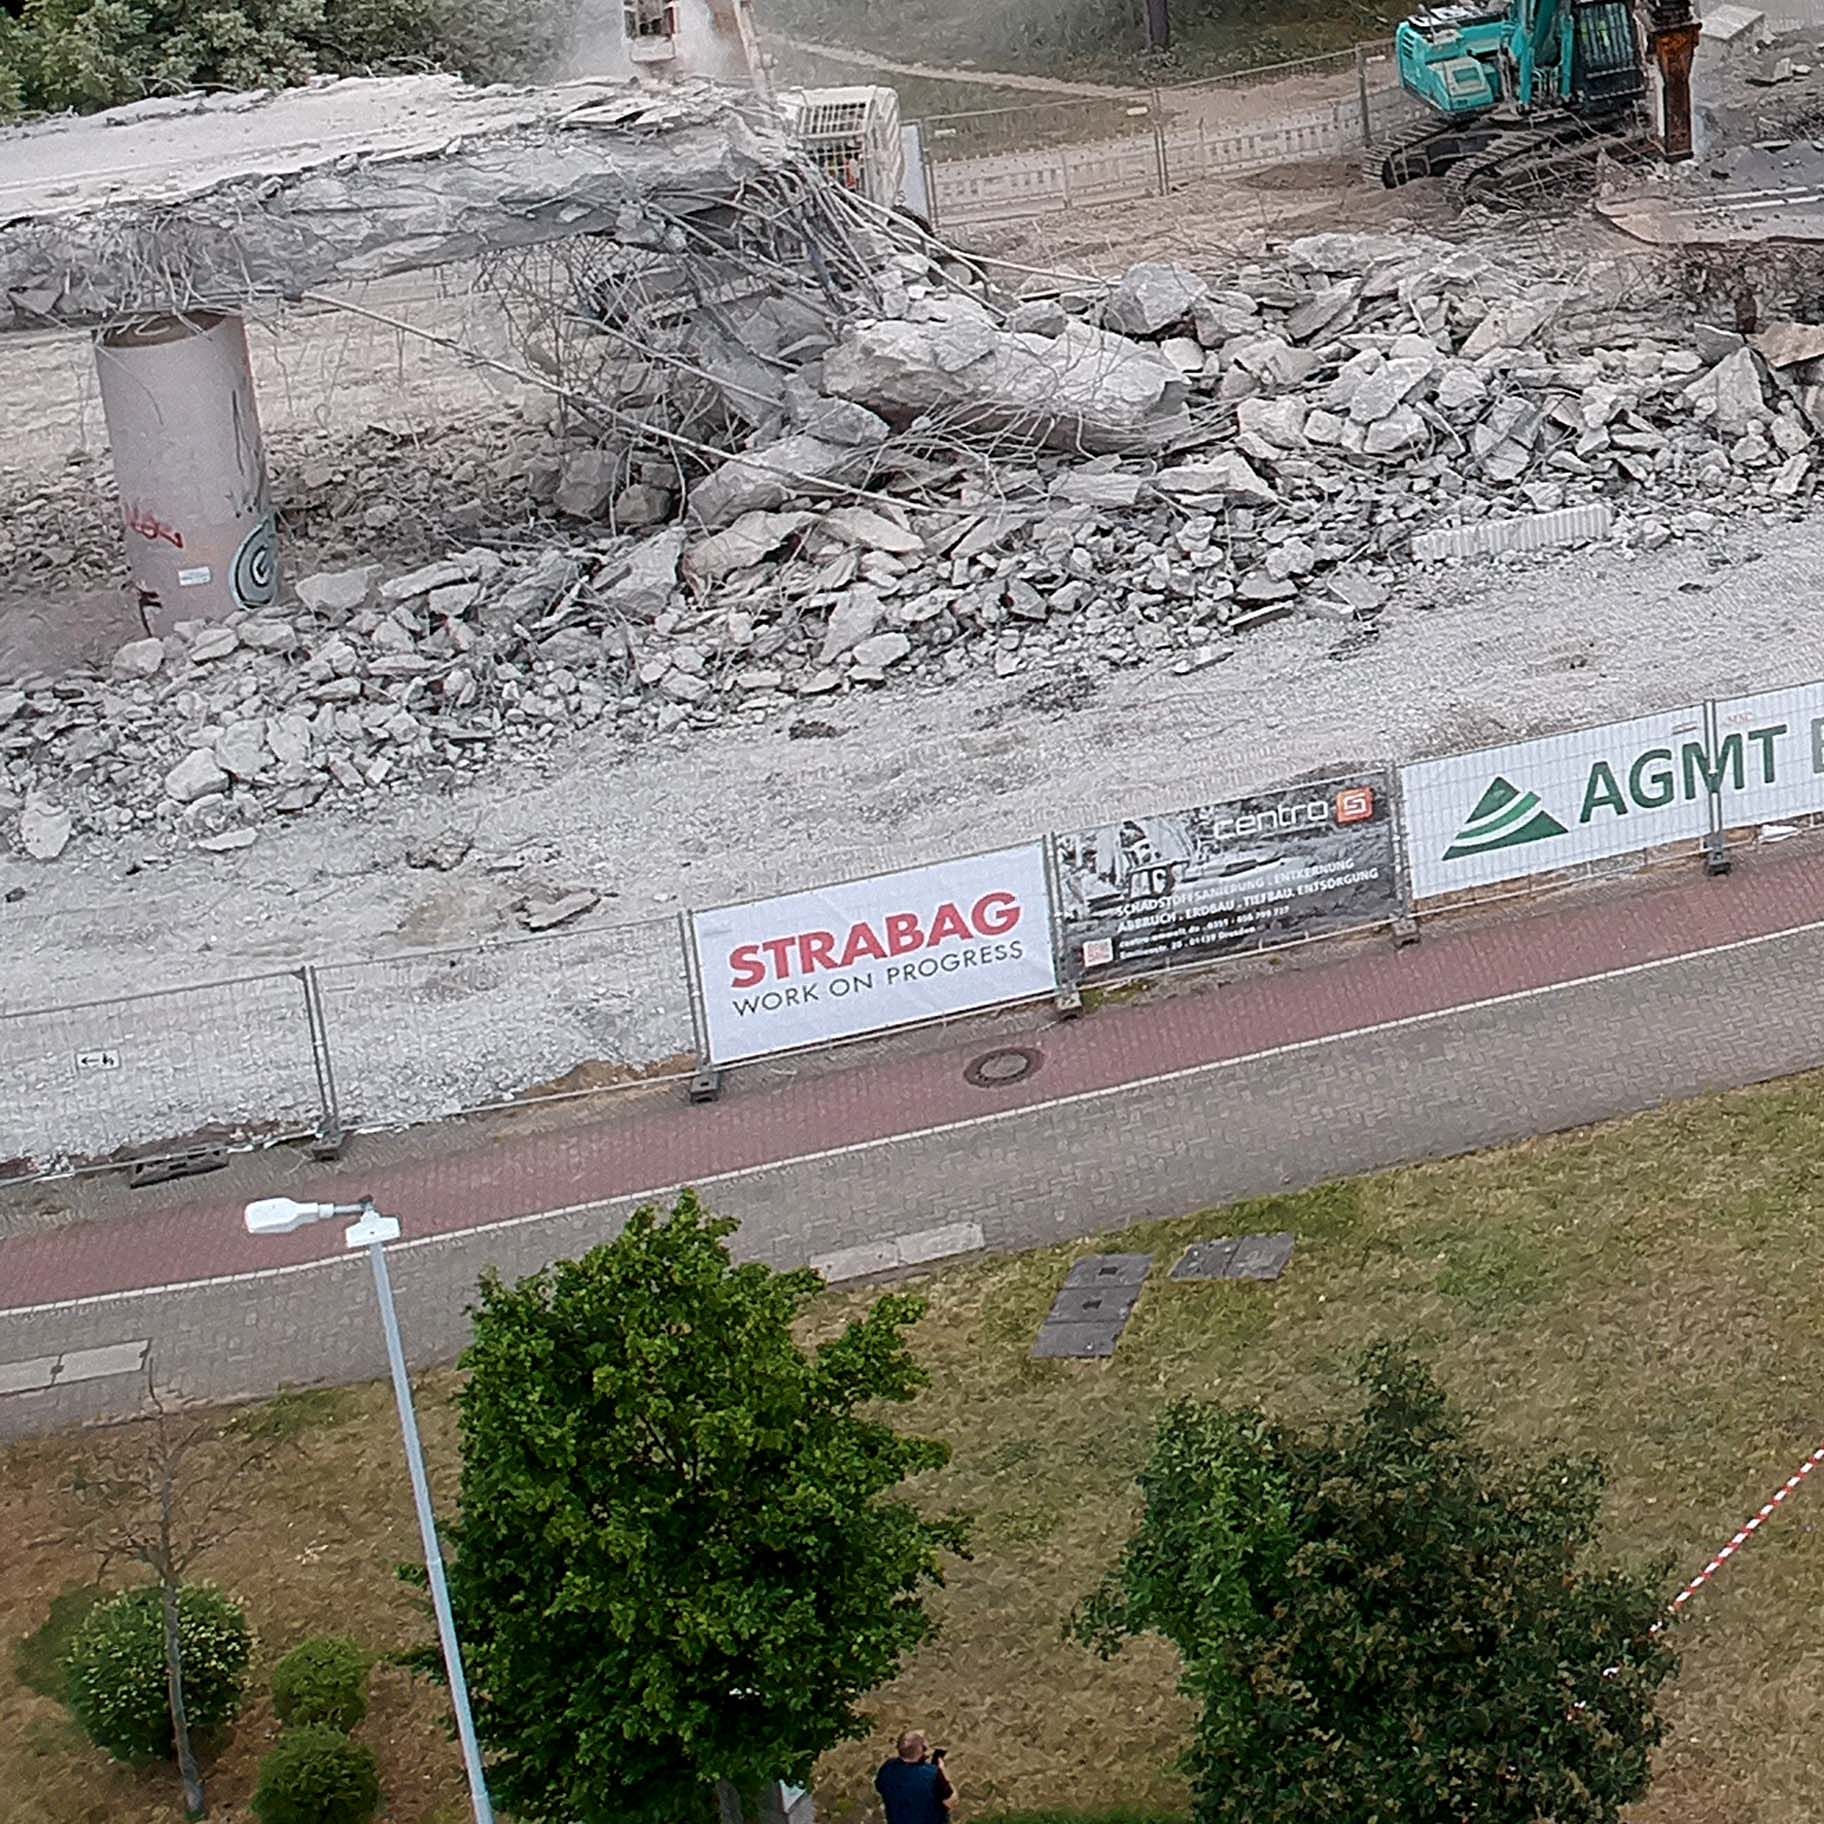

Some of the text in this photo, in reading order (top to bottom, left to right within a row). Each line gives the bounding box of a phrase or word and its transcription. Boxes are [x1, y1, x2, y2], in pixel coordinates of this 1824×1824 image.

[1580, 723, 1787, 824] AGMT
[1213, 799, 1329, 841] centro
[1117, 912, 1176, 934] ABBRUCH
[1185, 899, 1236, 919] ERDBAU
[1298, 868, 1379, 895] ENTSORGUNG
[1274, 858, 1355, 885] ENTKERNUNG
[729, 891, 1022, 988] STRABAG
[732, 940, 1024, 1016] WORK ON PROGRESS
